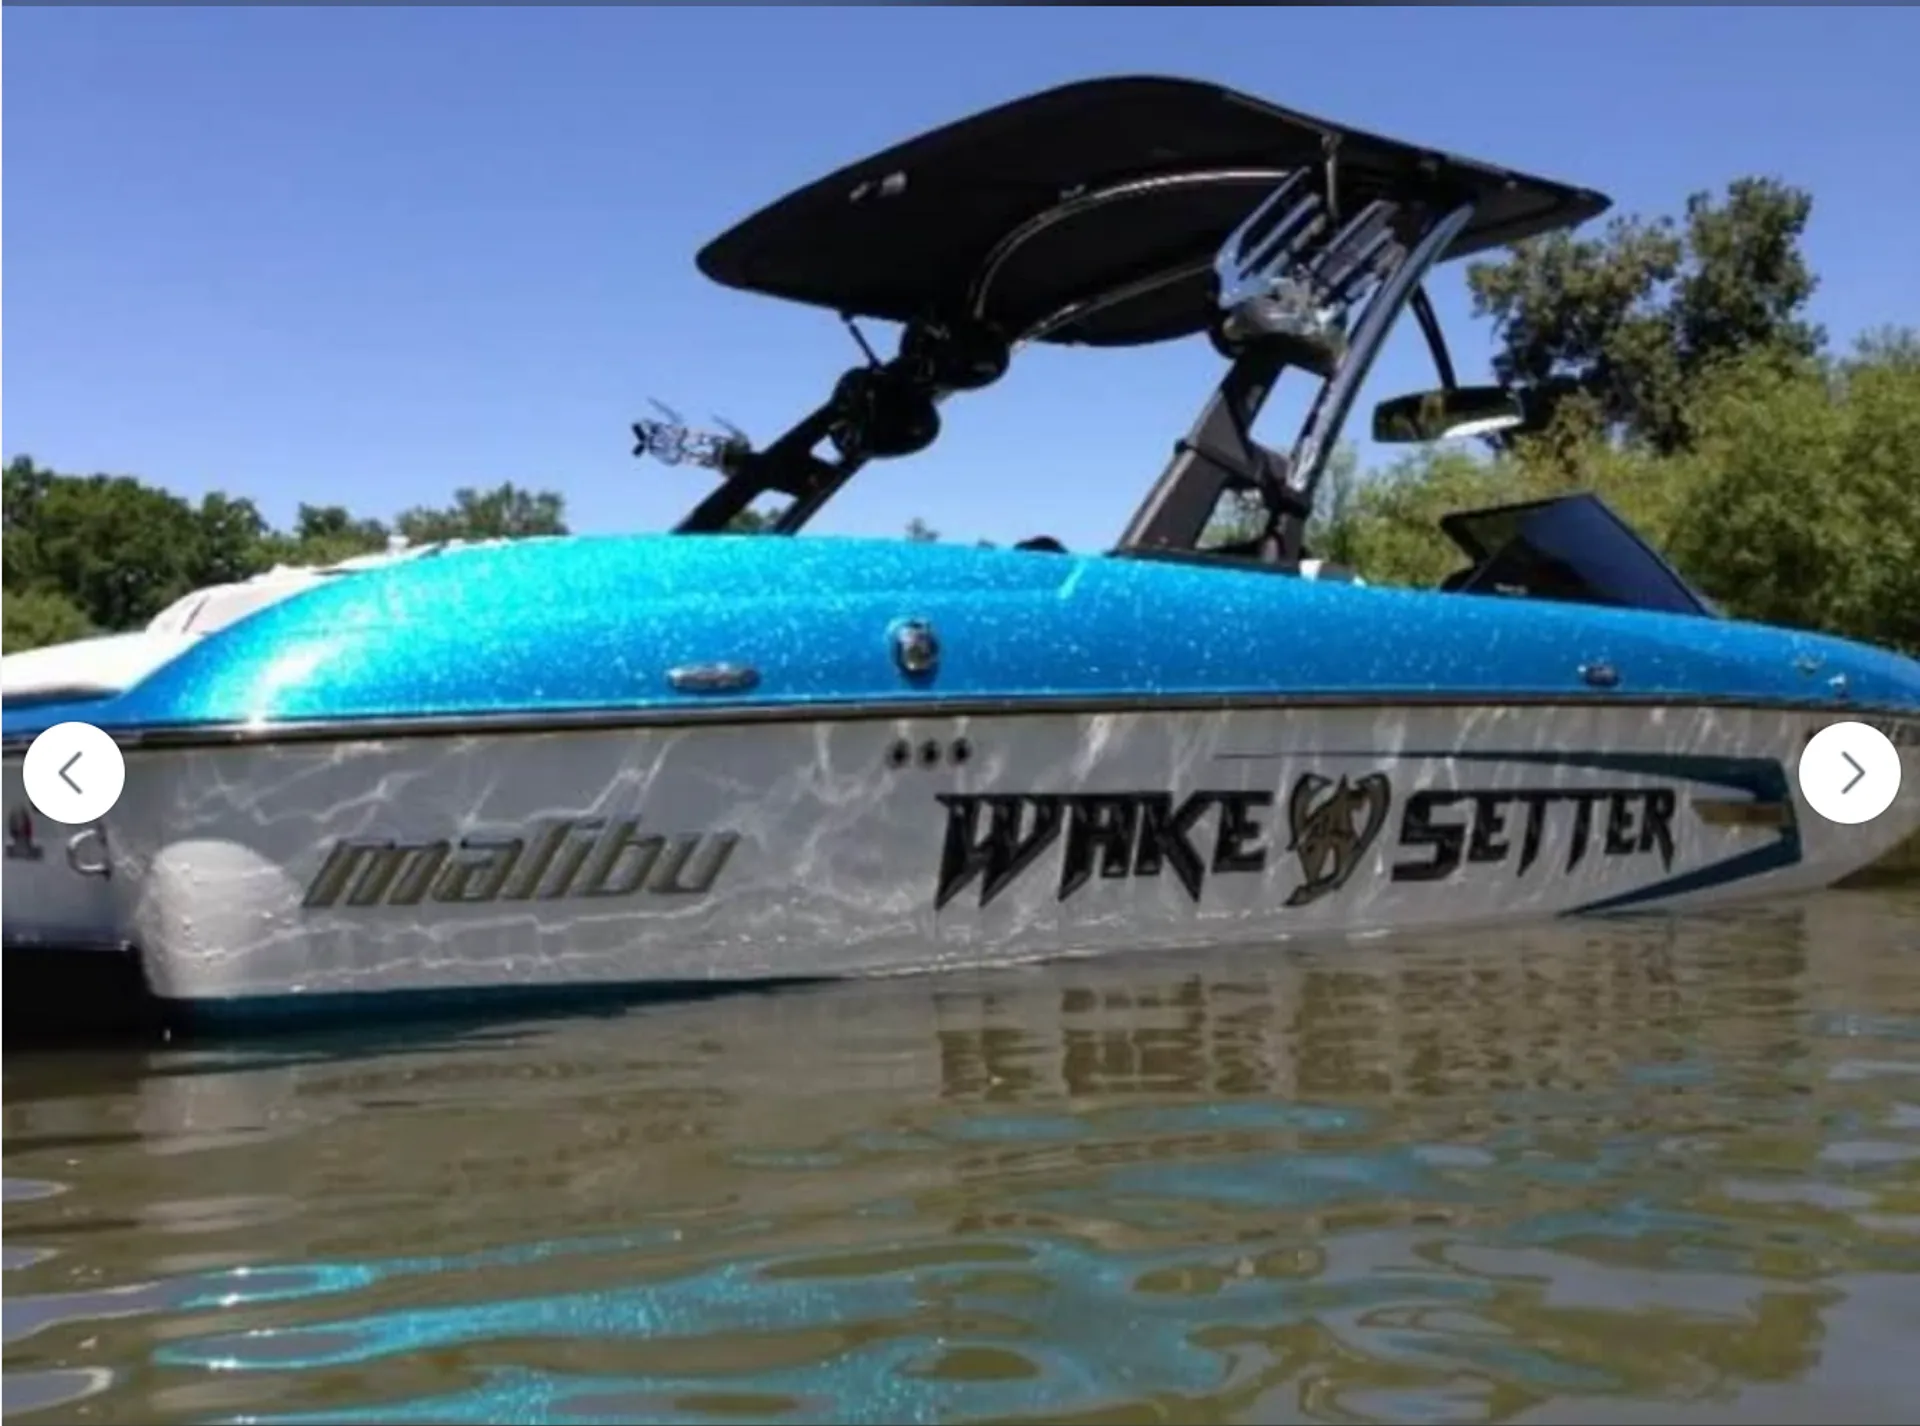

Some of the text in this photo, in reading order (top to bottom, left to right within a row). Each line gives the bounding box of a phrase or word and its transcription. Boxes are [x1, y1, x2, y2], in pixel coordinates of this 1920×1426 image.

[302, 815, 741, 907] malibu
[934, 788, 1675, 911] WAKE SETTER
